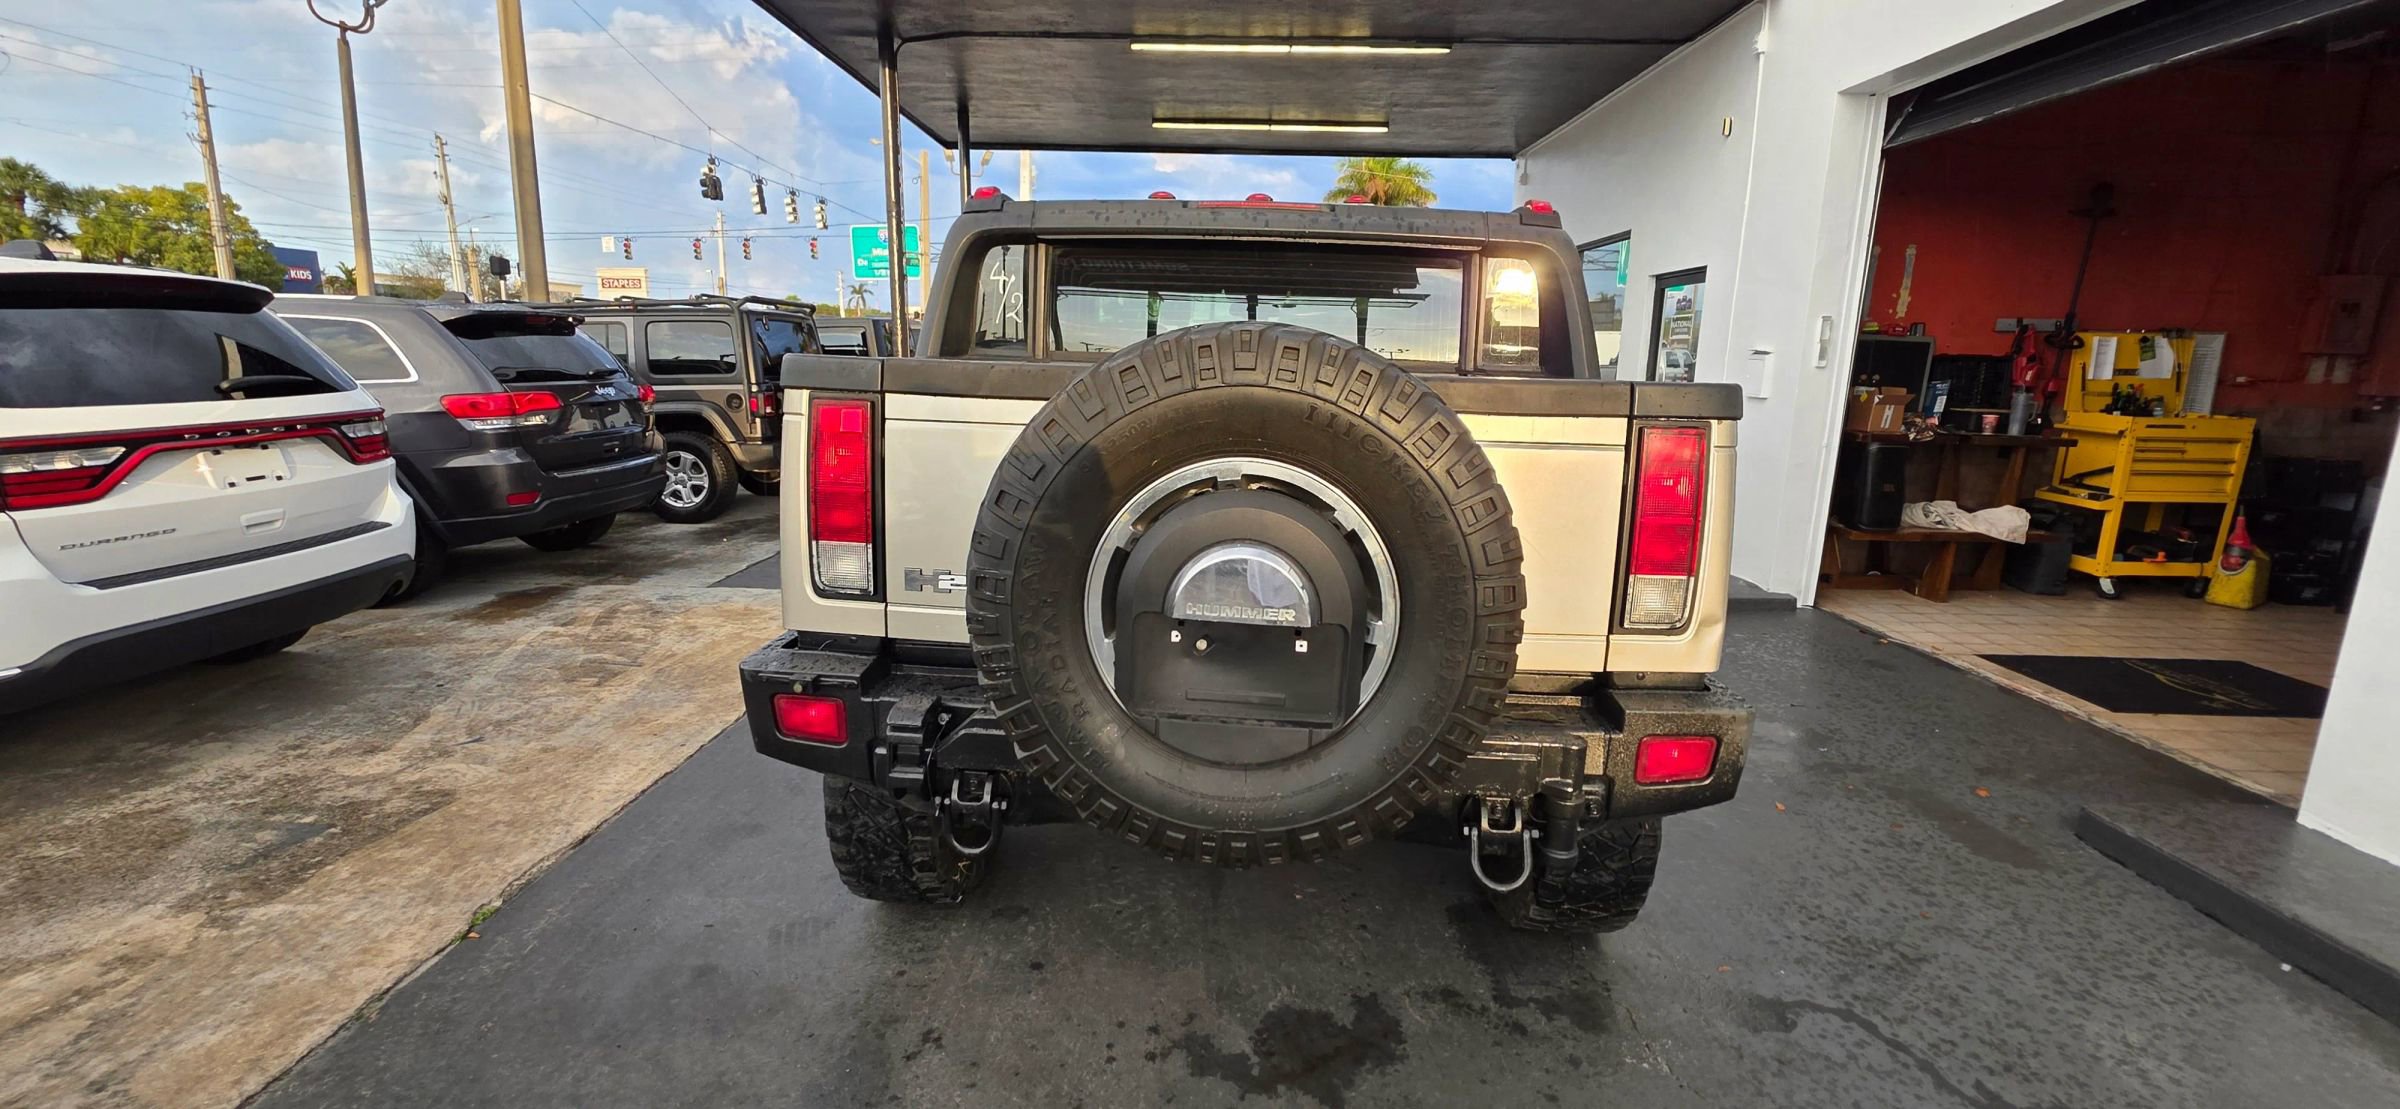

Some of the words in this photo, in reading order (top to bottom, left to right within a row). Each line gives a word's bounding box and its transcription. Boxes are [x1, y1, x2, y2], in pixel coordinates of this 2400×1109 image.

[290, 269, 312, 280] KIDS
[602, 279, 641, 288] STAPLES
[989, 261, 1024, 324] 4/2
[595, 384, 616, 397] Jeep
[184, 423, 308, 441] DODGE
[59, 527, 177, 551] DURANGO
[904, 566, 967, 594] H2
[1185, 602, 1297, 622] HUMMER
